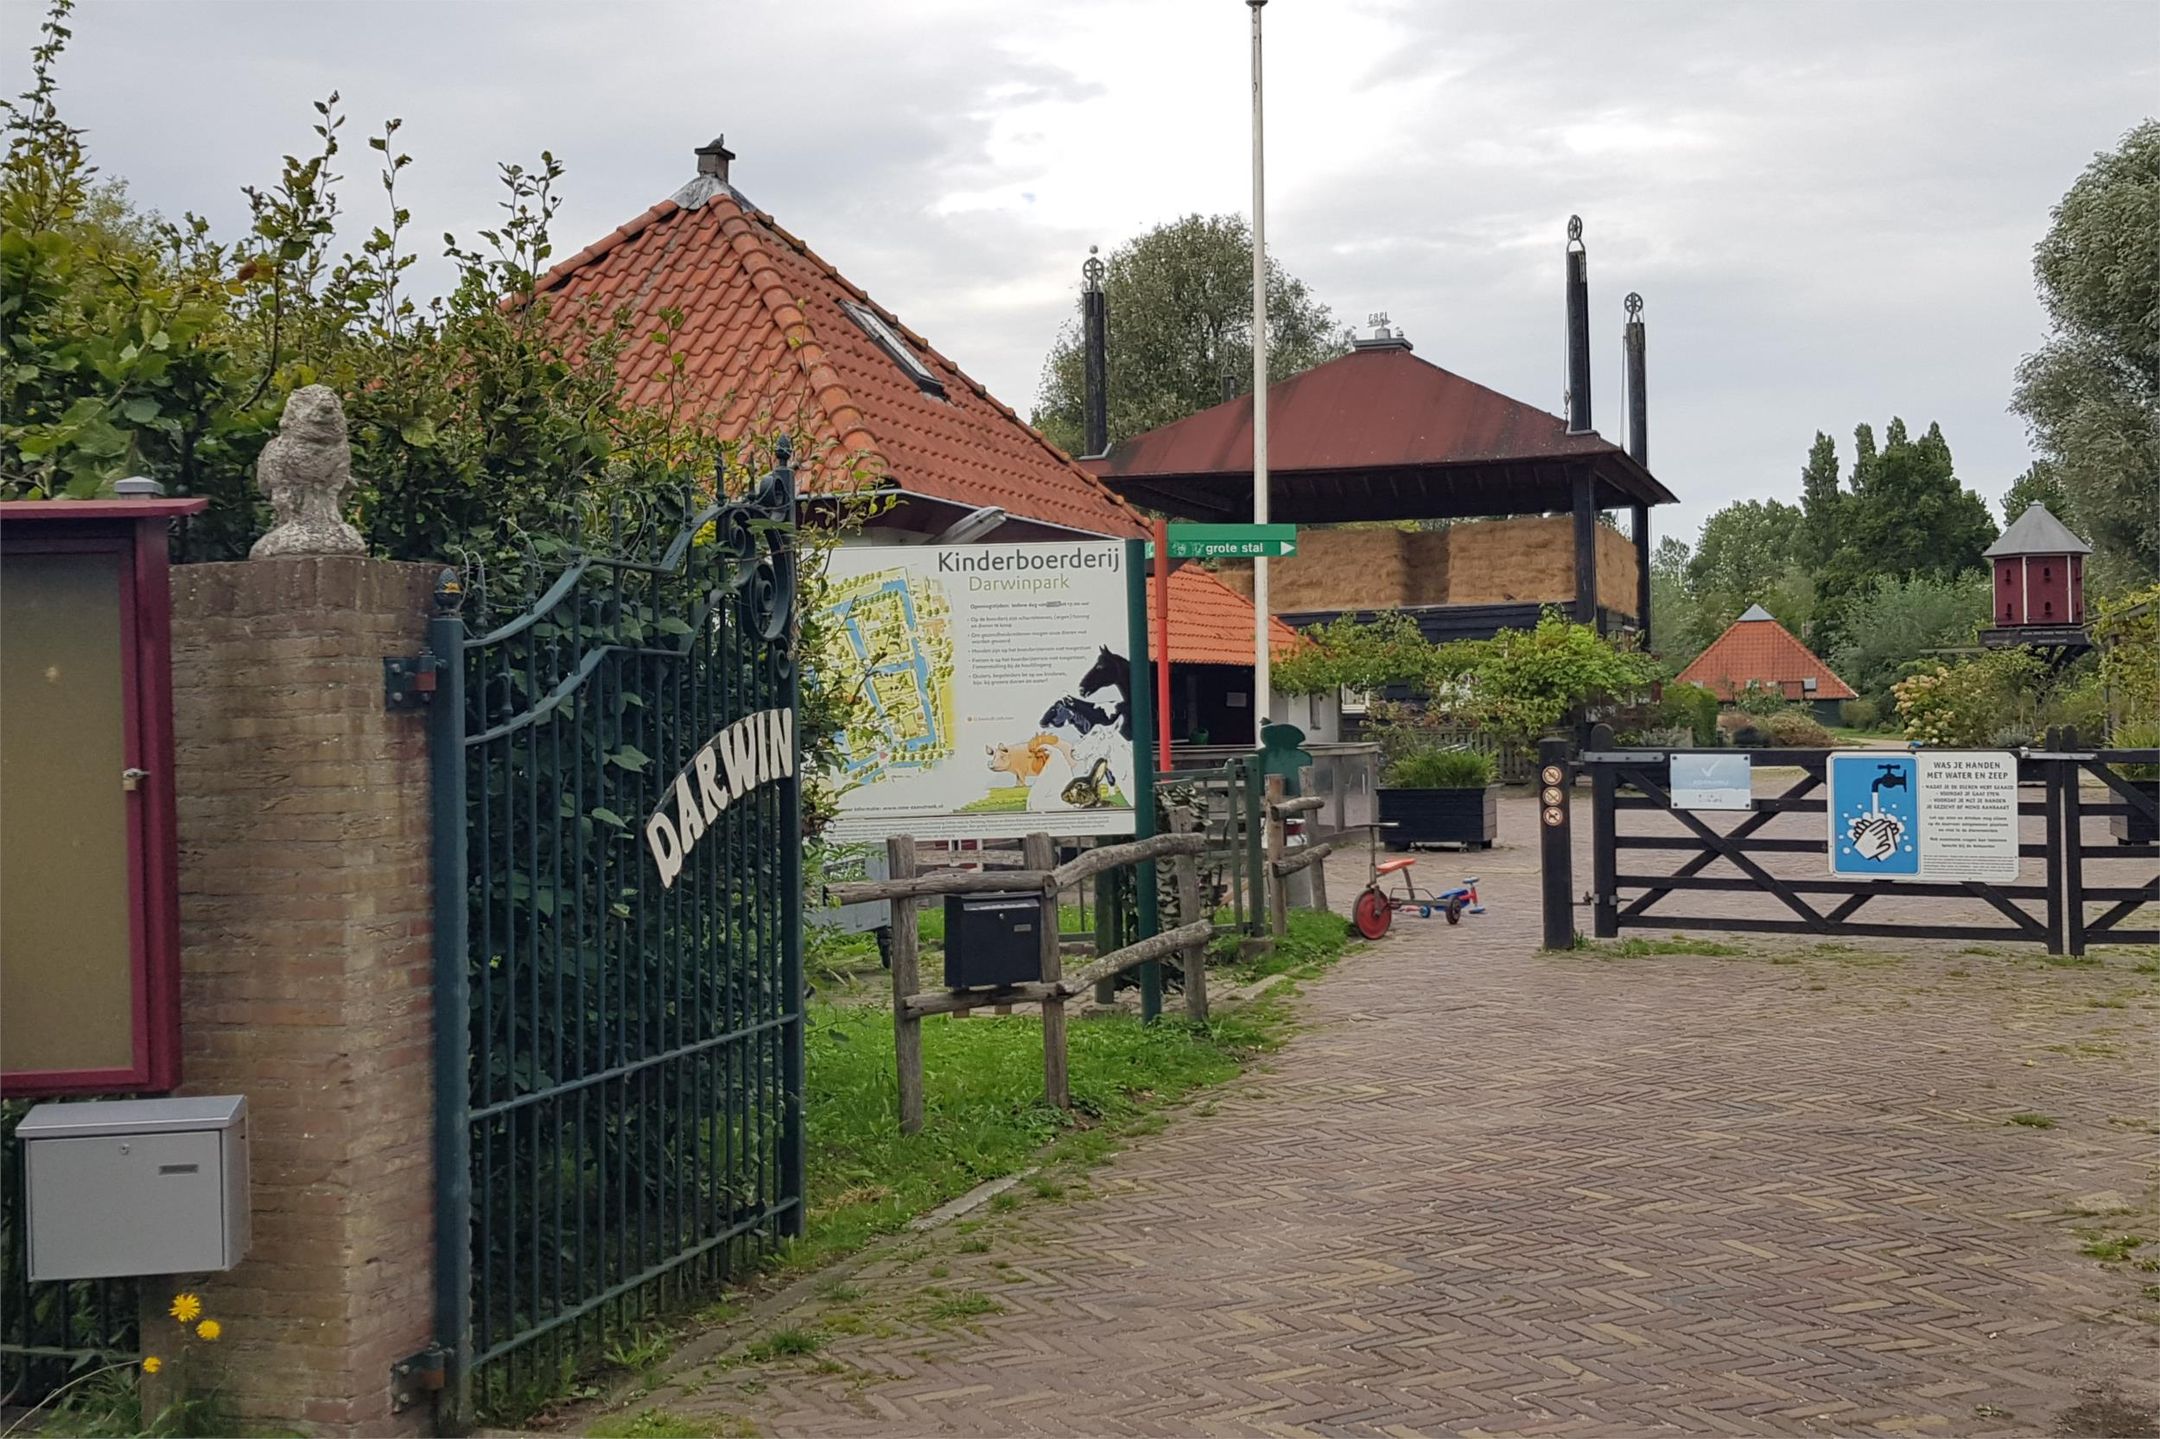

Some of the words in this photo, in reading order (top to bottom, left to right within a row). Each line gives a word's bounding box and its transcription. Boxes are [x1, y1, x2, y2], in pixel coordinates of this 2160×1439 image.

[1206, 543, 1237, 555] grote
[1241, 542, 1263, 553] stal
[938, 547, 1119, 573] Kinderboerderij
[969, 573, 1070, 594] Darwinpark
[1933, 761, 1951, 770] WAS
[1953, 761, 1963, 770] JE
[1965, 761, 2000, 770] HANDEN
[1927, 771, 1943, 780] MET
[1945, 771, 1972, 780] WATER
[1974, 771, 1985, 780] EN
[1988, 771, 2008, 780] ZEEP
[646, 707, 793, 889] DARWIN
